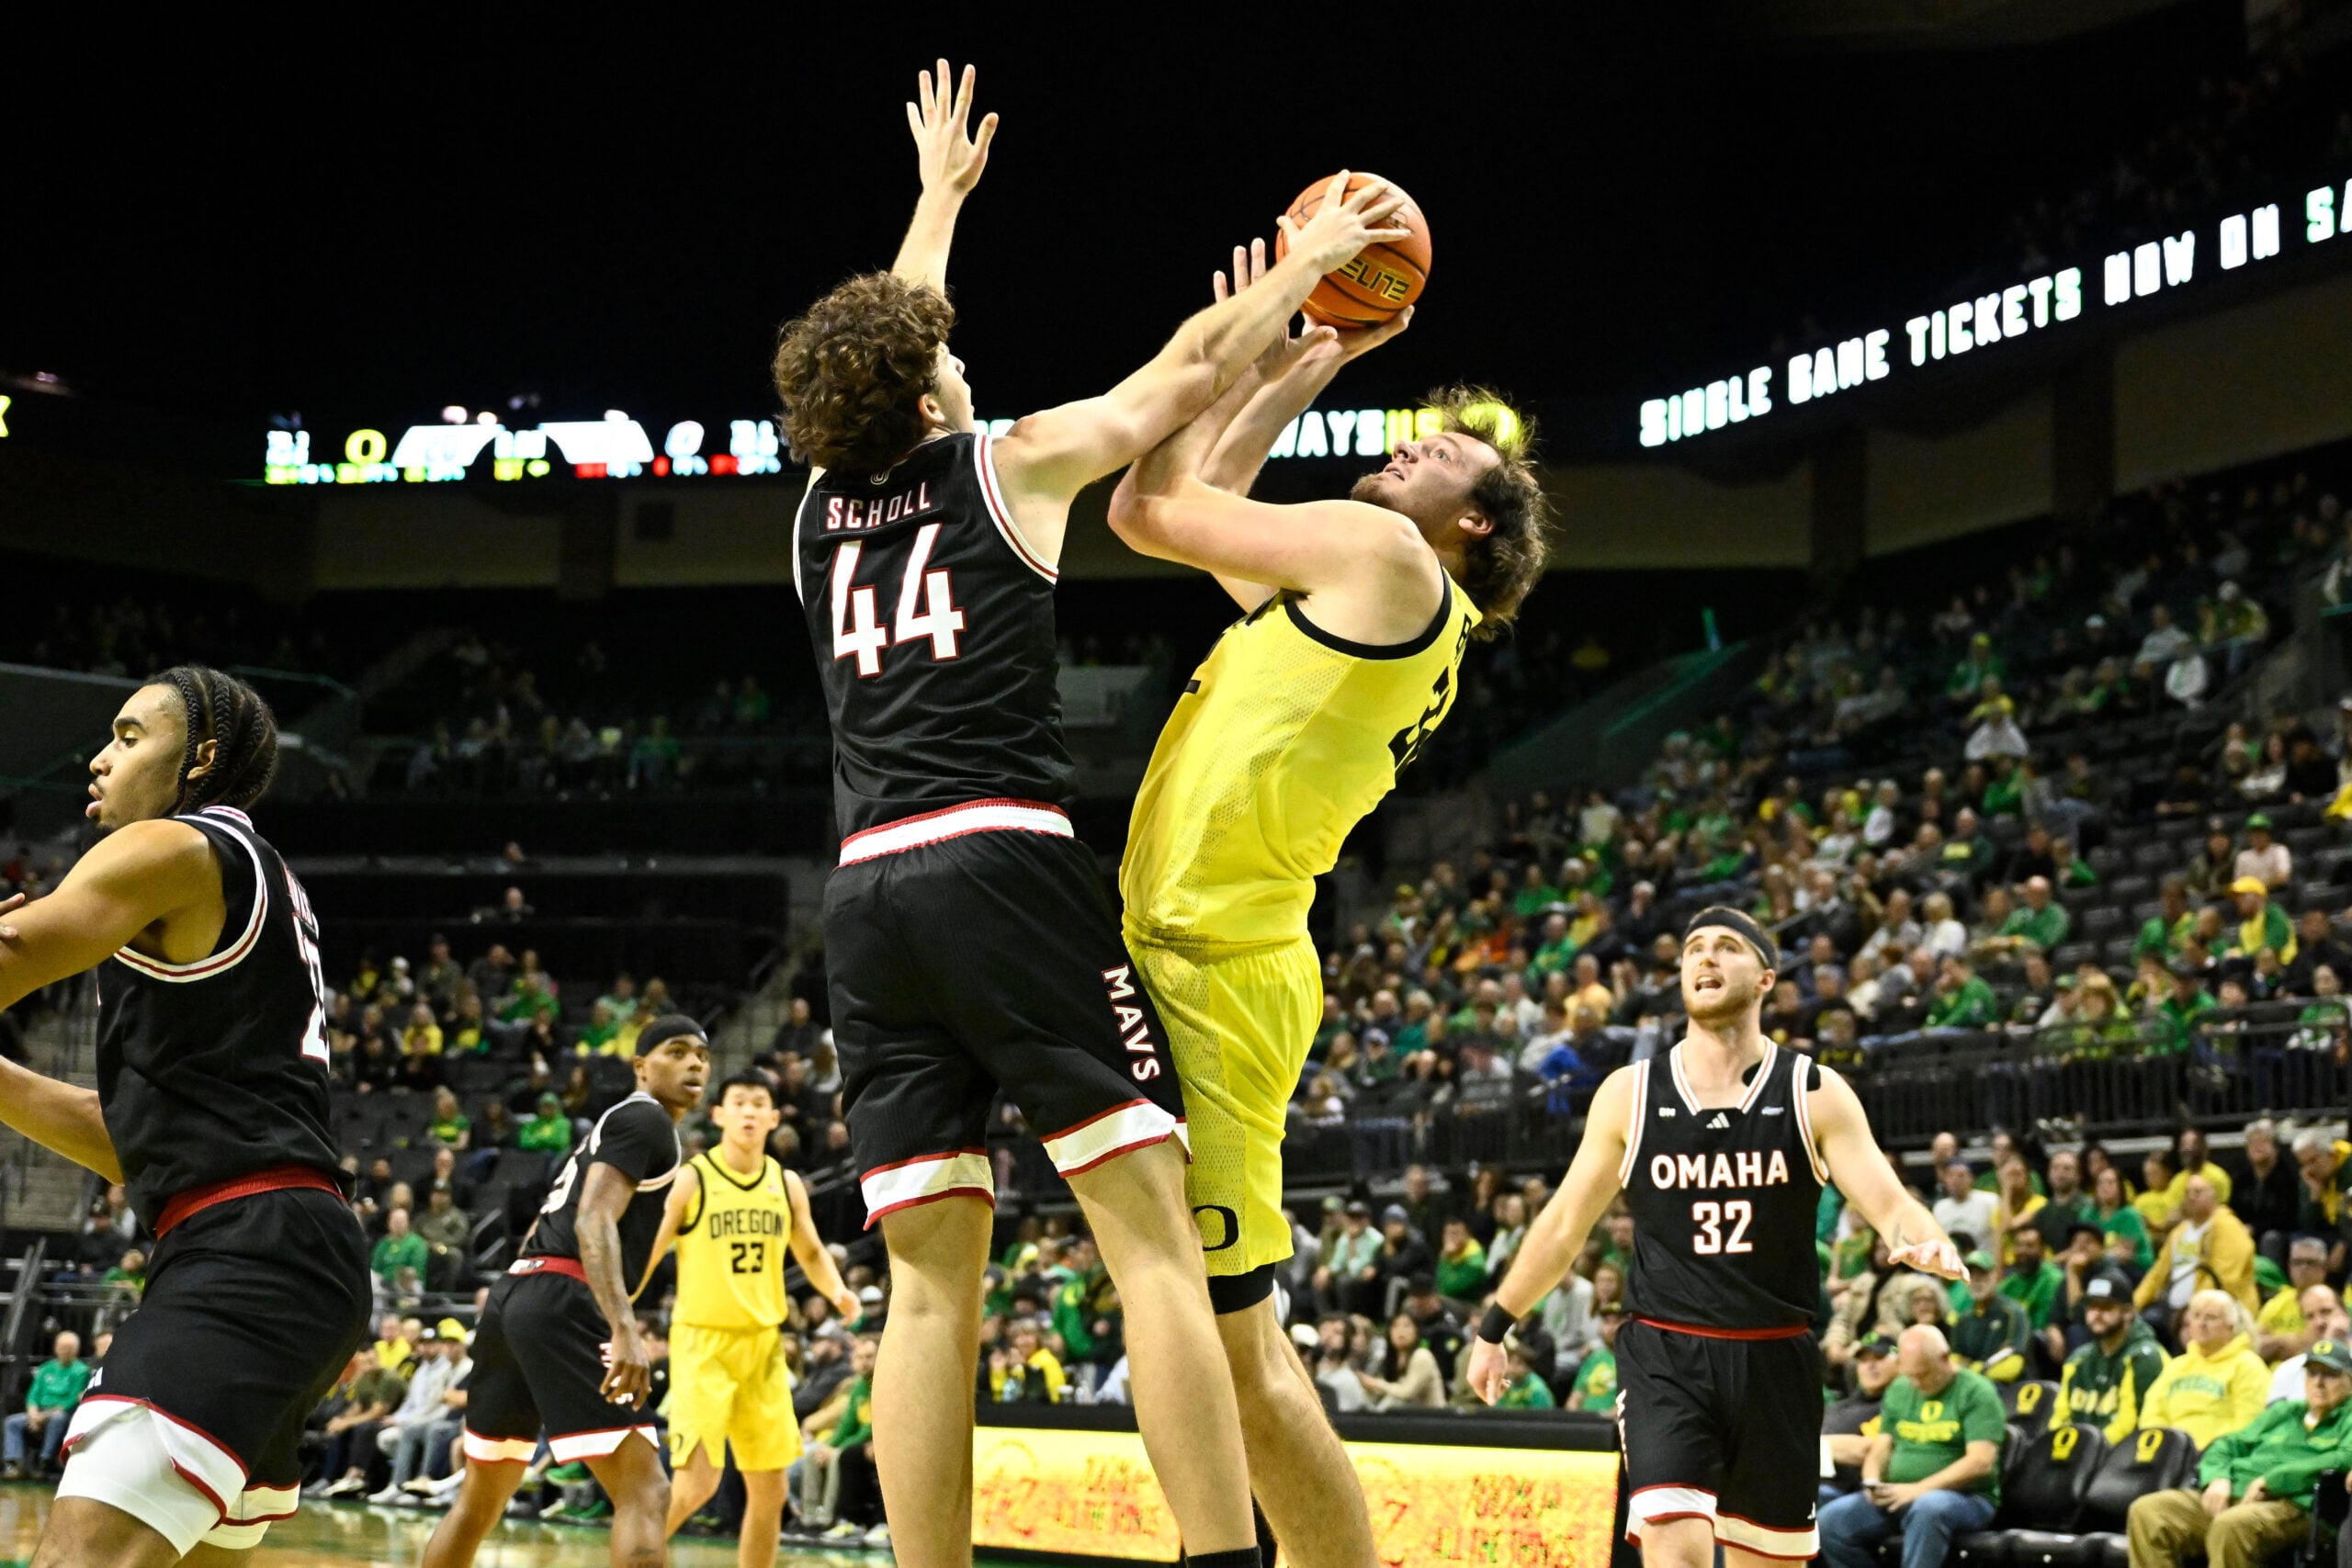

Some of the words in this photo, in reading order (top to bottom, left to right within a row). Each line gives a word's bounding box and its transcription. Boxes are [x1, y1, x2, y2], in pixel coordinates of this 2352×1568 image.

[1337, 258, 1410, 302] ELITE
[1640, 367, 1771, 446] SINGLE
[1789, 329, 1889, 404] GAME
[1905, 267, 2081, 368] TICKETS
[2105, 231, 2195, 306] NOW
[2221, 204, 2279, 269] ON
[827, 481, 931, 530] SCHOLL
[831, 522, 967, 679] 44
[1102, 963, 1161, 1082] MAVS
[1650, 1150, 1789, 1190] OMAHA
[709, 1208, 785, 1240] OREGON
[1692, 1200, 1753, 1255] 32
[730, 1243, 764, 1274] 23
